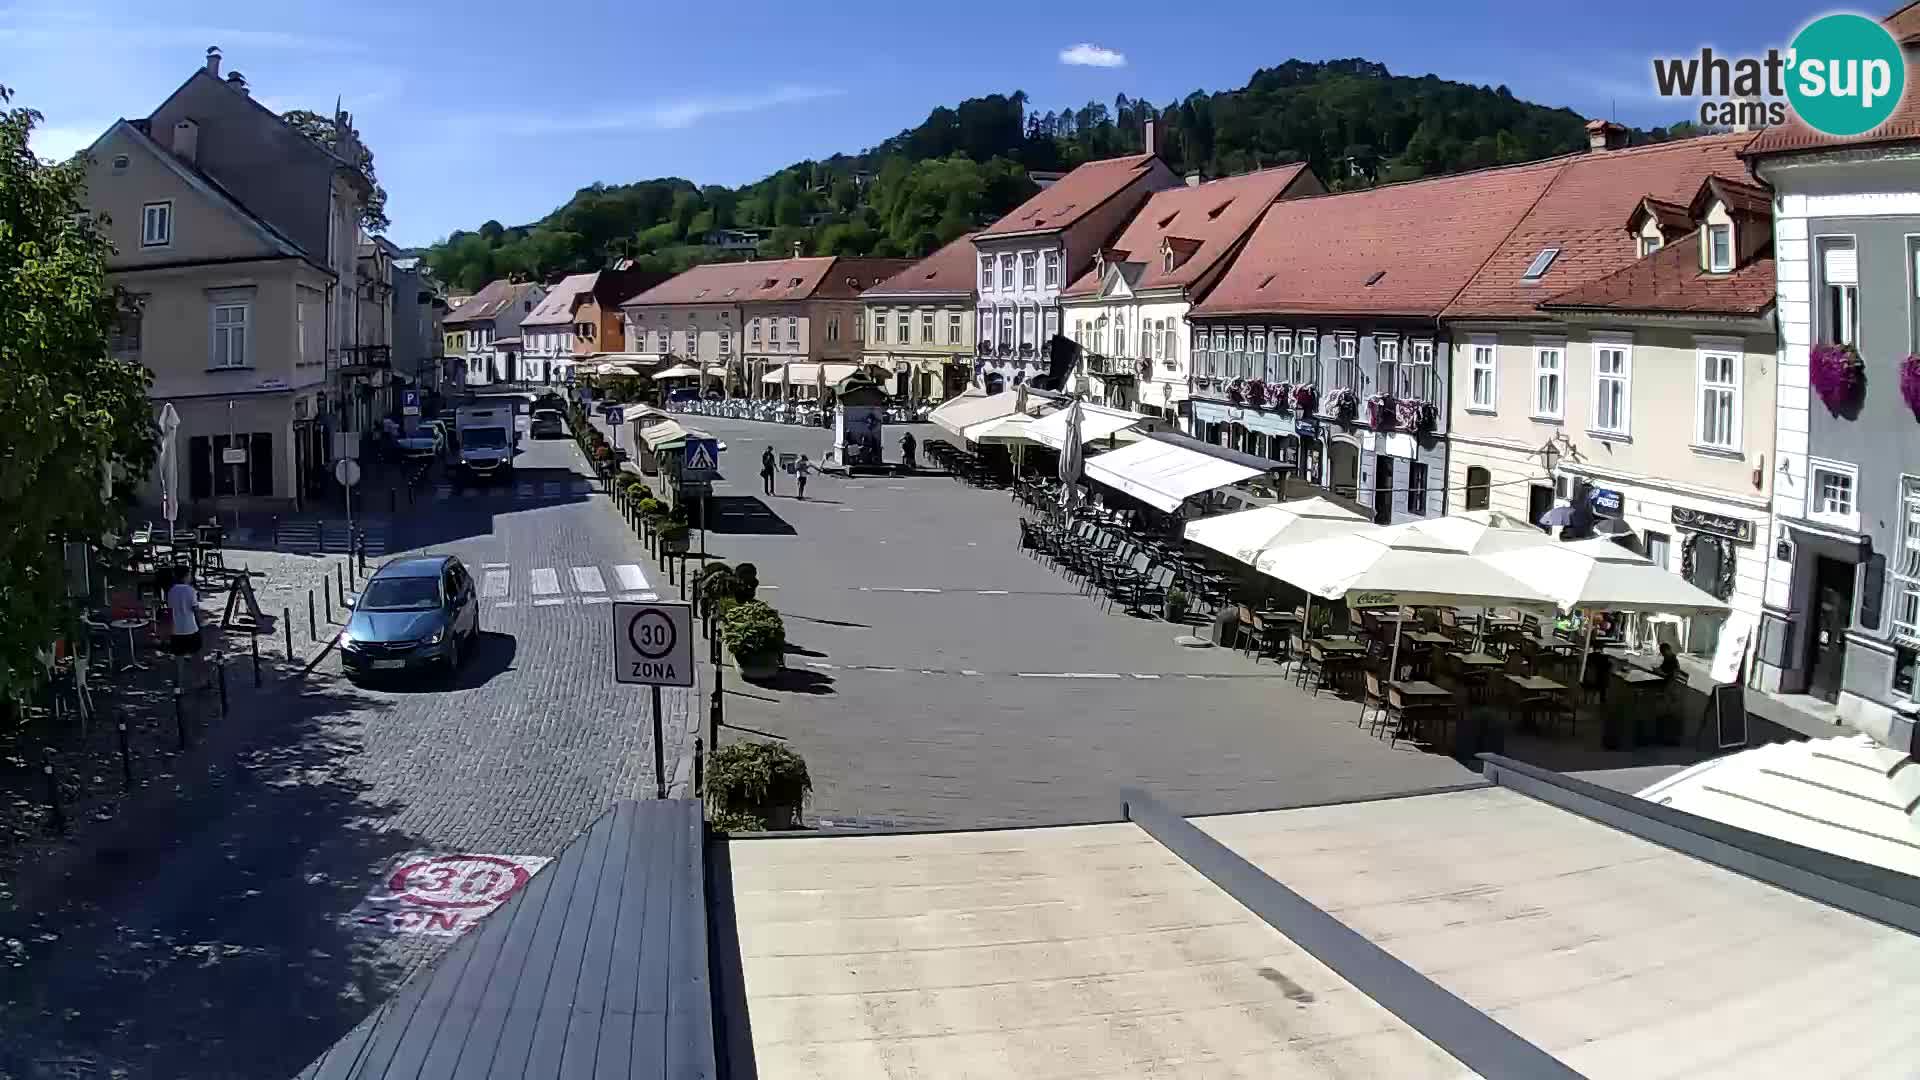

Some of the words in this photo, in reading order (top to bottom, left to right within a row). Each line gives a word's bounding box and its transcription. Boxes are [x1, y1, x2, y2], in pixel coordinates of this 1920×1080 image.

[641, 624, 665, 646] 30
[631, 662, 676, 679] ZONA
[415, 867, 502, 894] 30
